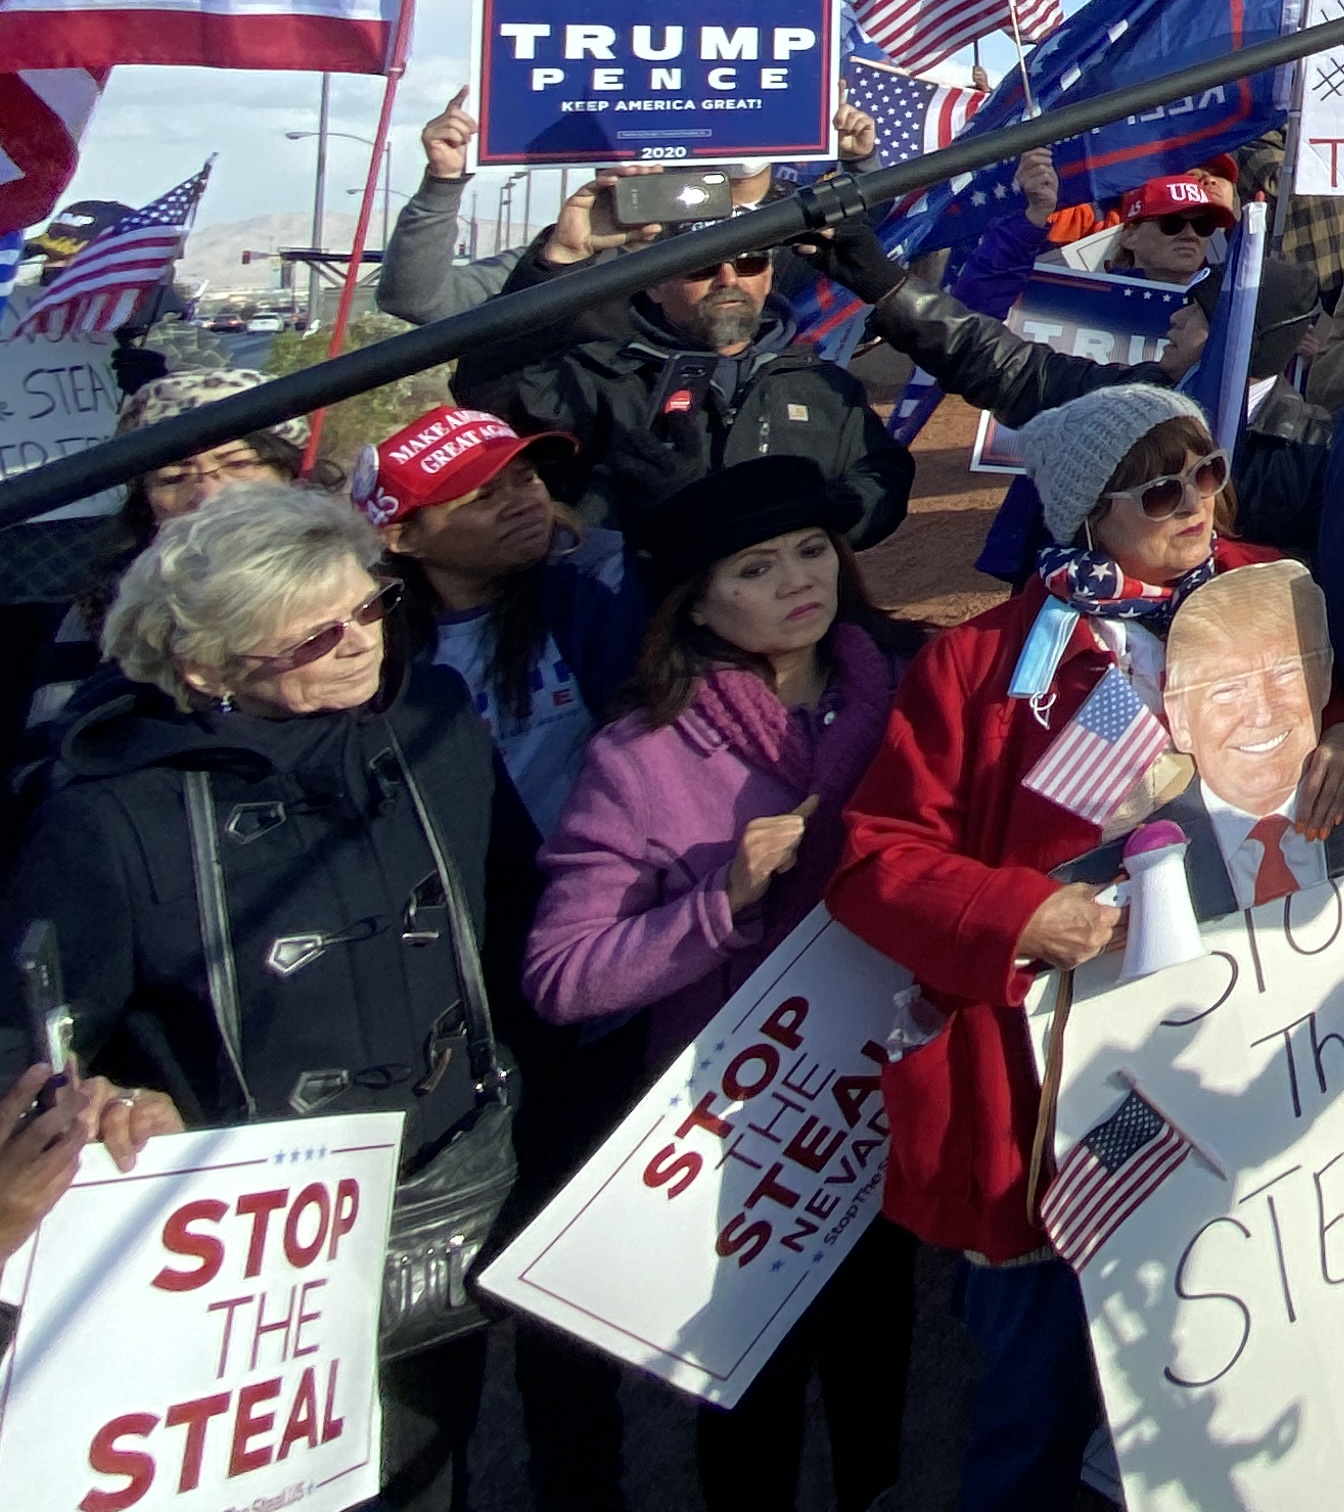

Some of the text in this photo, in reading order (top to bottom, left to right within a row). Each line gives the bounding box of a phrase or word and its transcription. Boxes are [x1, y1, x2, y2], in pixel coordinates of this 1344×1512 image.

[499, 22, 817, 61] TRUMP
[531, 67, 789, 92] PENCE
[561, 97, 763, 113] KEEP AMERICA GREAT!
[641, 146, 687, 159] 2020
[389, 421, 451, 465] MAKE
[420, 429, 482, 474] GREAT
[642, 995, 810, 1201] STOP
[714, 1052, 837, 1170] THE
[148, 1177, 361, 1293] STOP
[206, 1278, 329, 1380] THE
[77, 1357, 346, 1512] STEAL
